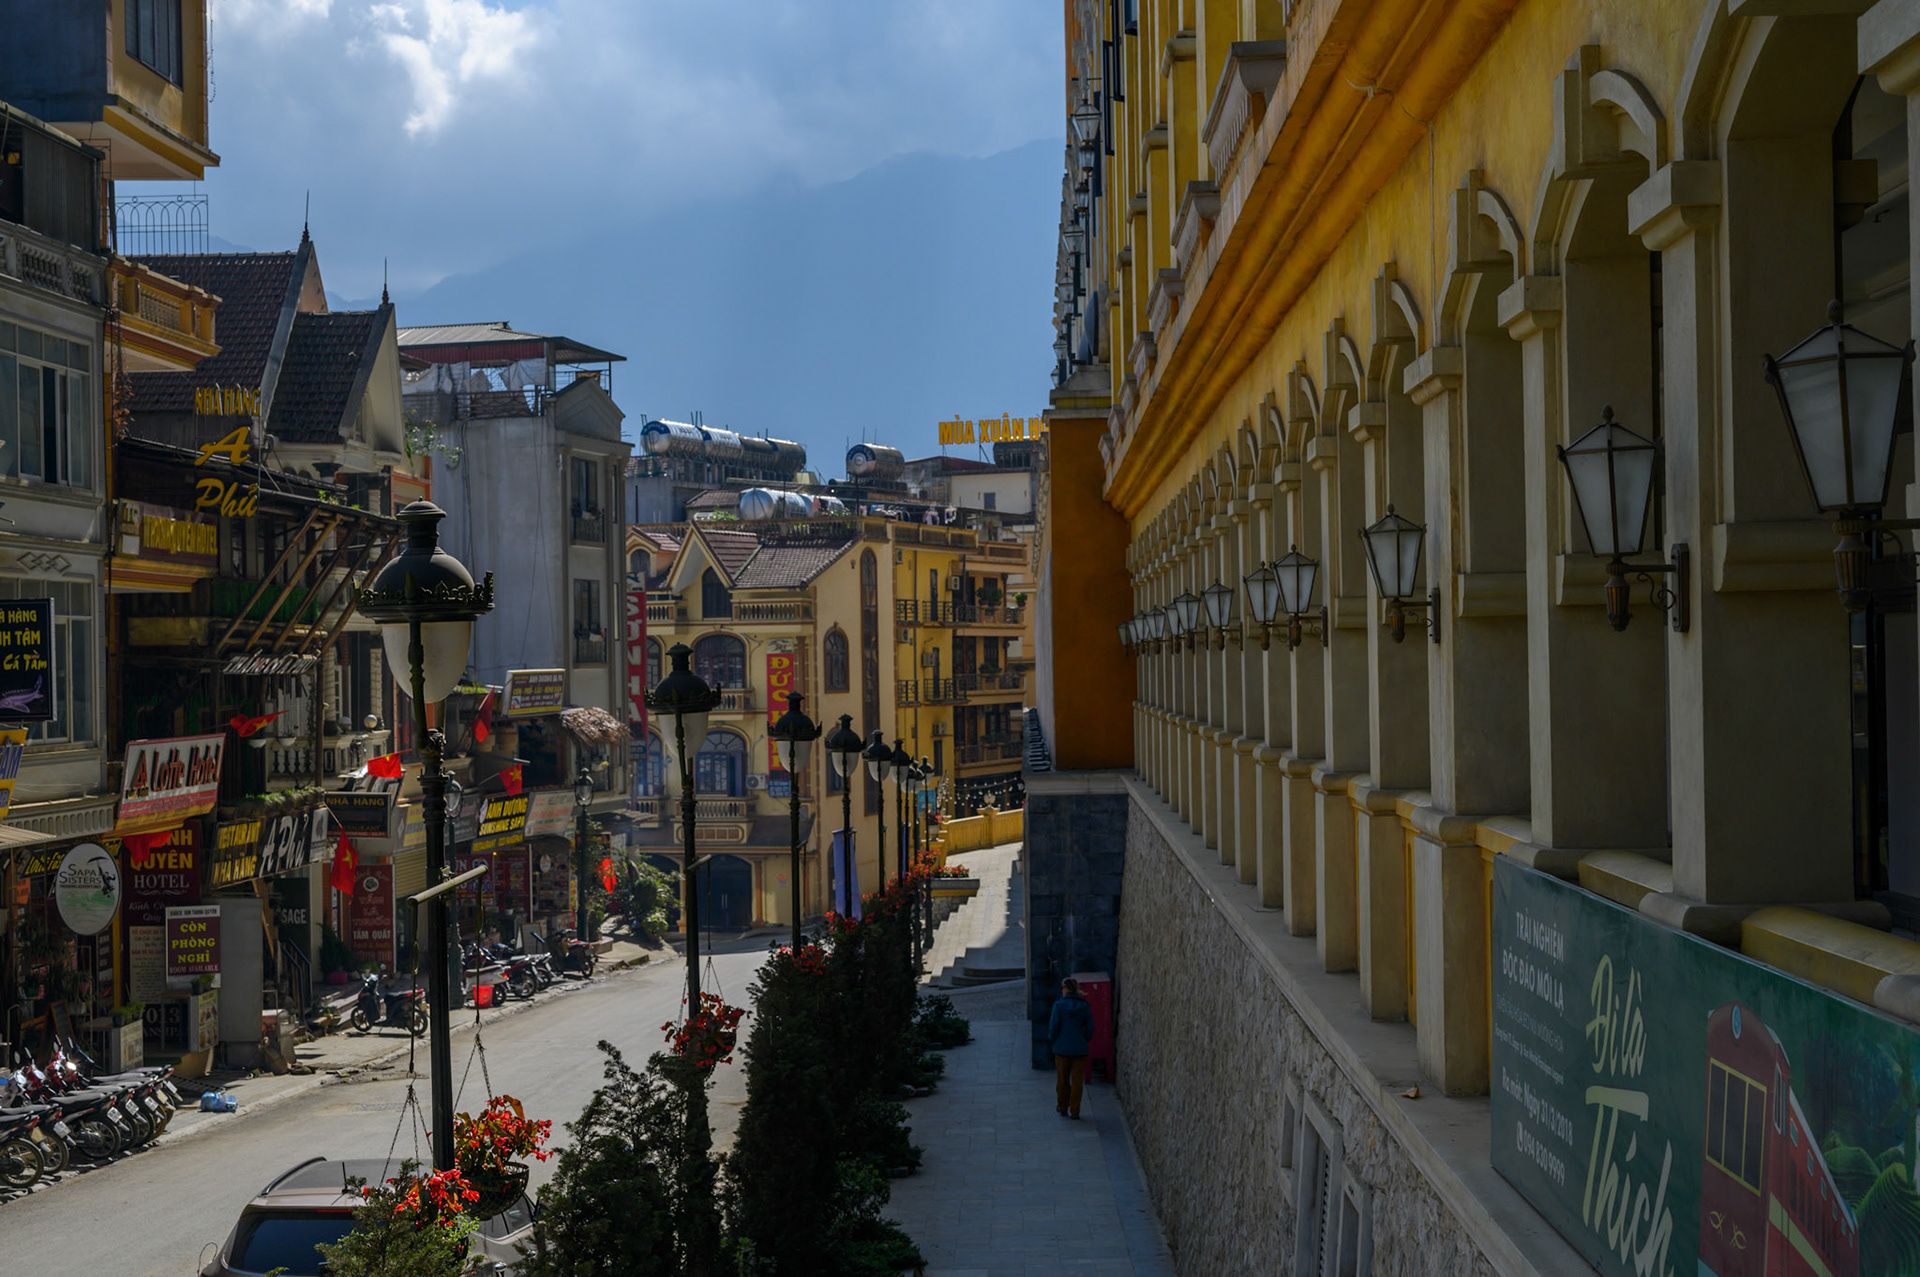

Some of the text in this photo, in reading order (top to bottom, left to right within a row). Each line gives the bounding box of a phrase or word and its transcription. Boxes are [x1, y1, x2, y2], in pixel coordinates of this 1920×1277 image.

[195, 382, 261, 416] NHÀ HÀNG
[194, 425, 250, 466] A
[939, 414, 975, 445] MÙA
[979, 412, 1024, 443] XUÂN
[195, 477, 259, 517] Phủ
[8, 607, 37, 624] HÀNG
[0, 626, 41, 647] H TÂM
[3, 653, 20, 671] Cá
[769, 656, 793, 702] ĐỨC
[131, 744, 221, 792] A Lotte Hotel
[353, 796, 385, 806] HÀNG
[258, 818, 277, 878] A
[59, 871, 102, 884] SISTERS
[68, 863, 97, 877] SAPA
[134, 874, 190, 889] HOTEL
[212, 851, 258, 885] NHÀ HÀNG
[171, 936, 216, 949] PHÒNG
[180, 920, 207, 933] CÒN
[1516, 907, 1564, 966] TRẢI NGHIỆM
[177, 949, 210, 964] NGHỈ
[1503, 945, 1517, 986] ĐỘC
[1536, 965, 1552, 1004] MỚI
[1554, 978, 1564, 1018] LẠ
[1585, 954, 1620, 1078] Đi
[1622, 965, 1647, 1078] là
[1502, 1066, 1510, 1092] Ra
[1524, 1081, 1541, 1124] Ngày
[1541, 1098, 1573, 1147] 31/3/2018
[1523, 1129, 1565, 1187] 094 830 9999
[1583, 1085, 1675, 1277] Thích
